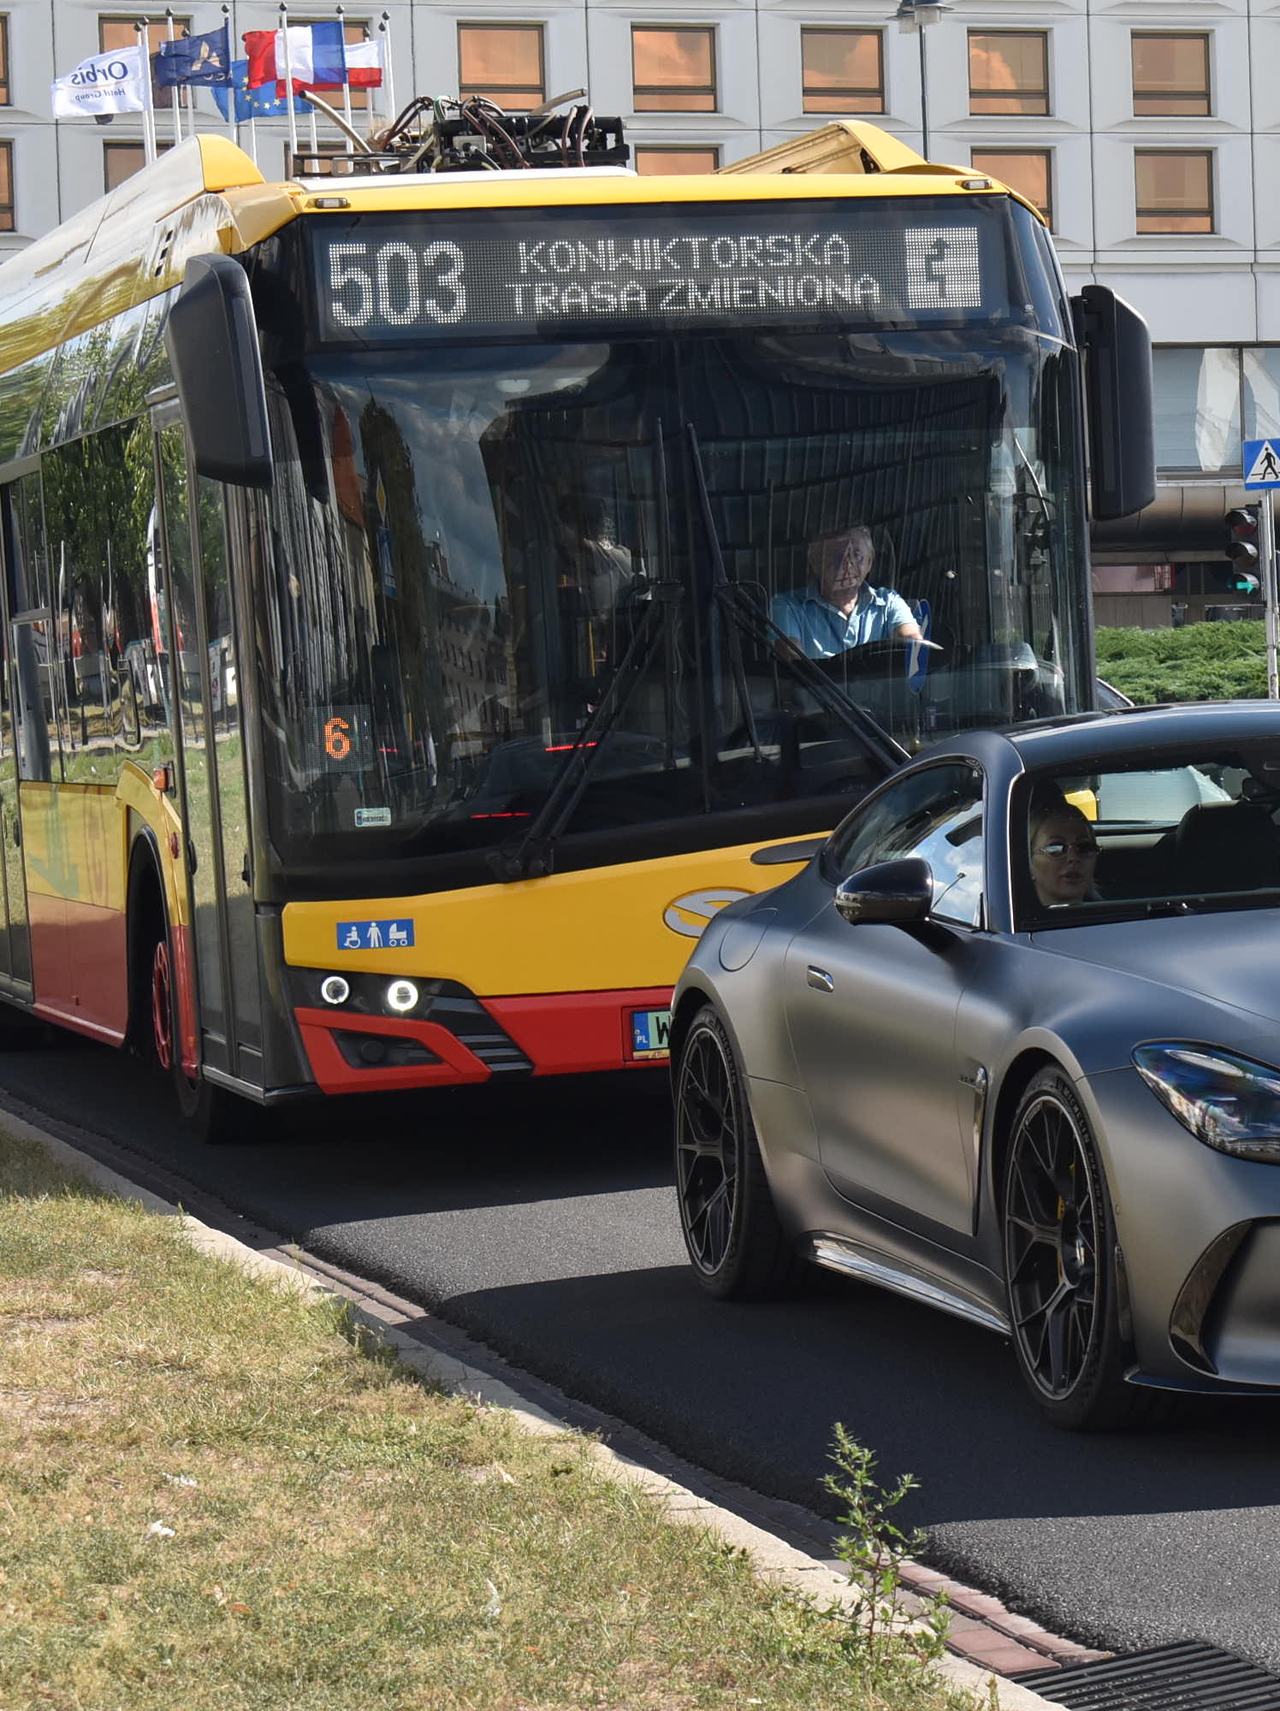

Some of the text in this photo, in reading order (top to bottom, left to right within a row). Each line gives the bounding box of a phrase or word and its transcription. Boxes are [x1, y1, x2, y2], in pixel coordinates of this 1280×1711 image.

[518, 234, 850, 273] KONWIKTORSKA
[329, 241, 466, 326] 503
[505, 273, 880, 315] TRASA ZMIENIONA
[324, 717, 351, 759] 6
[637, 1035, 649, 1044] PL
